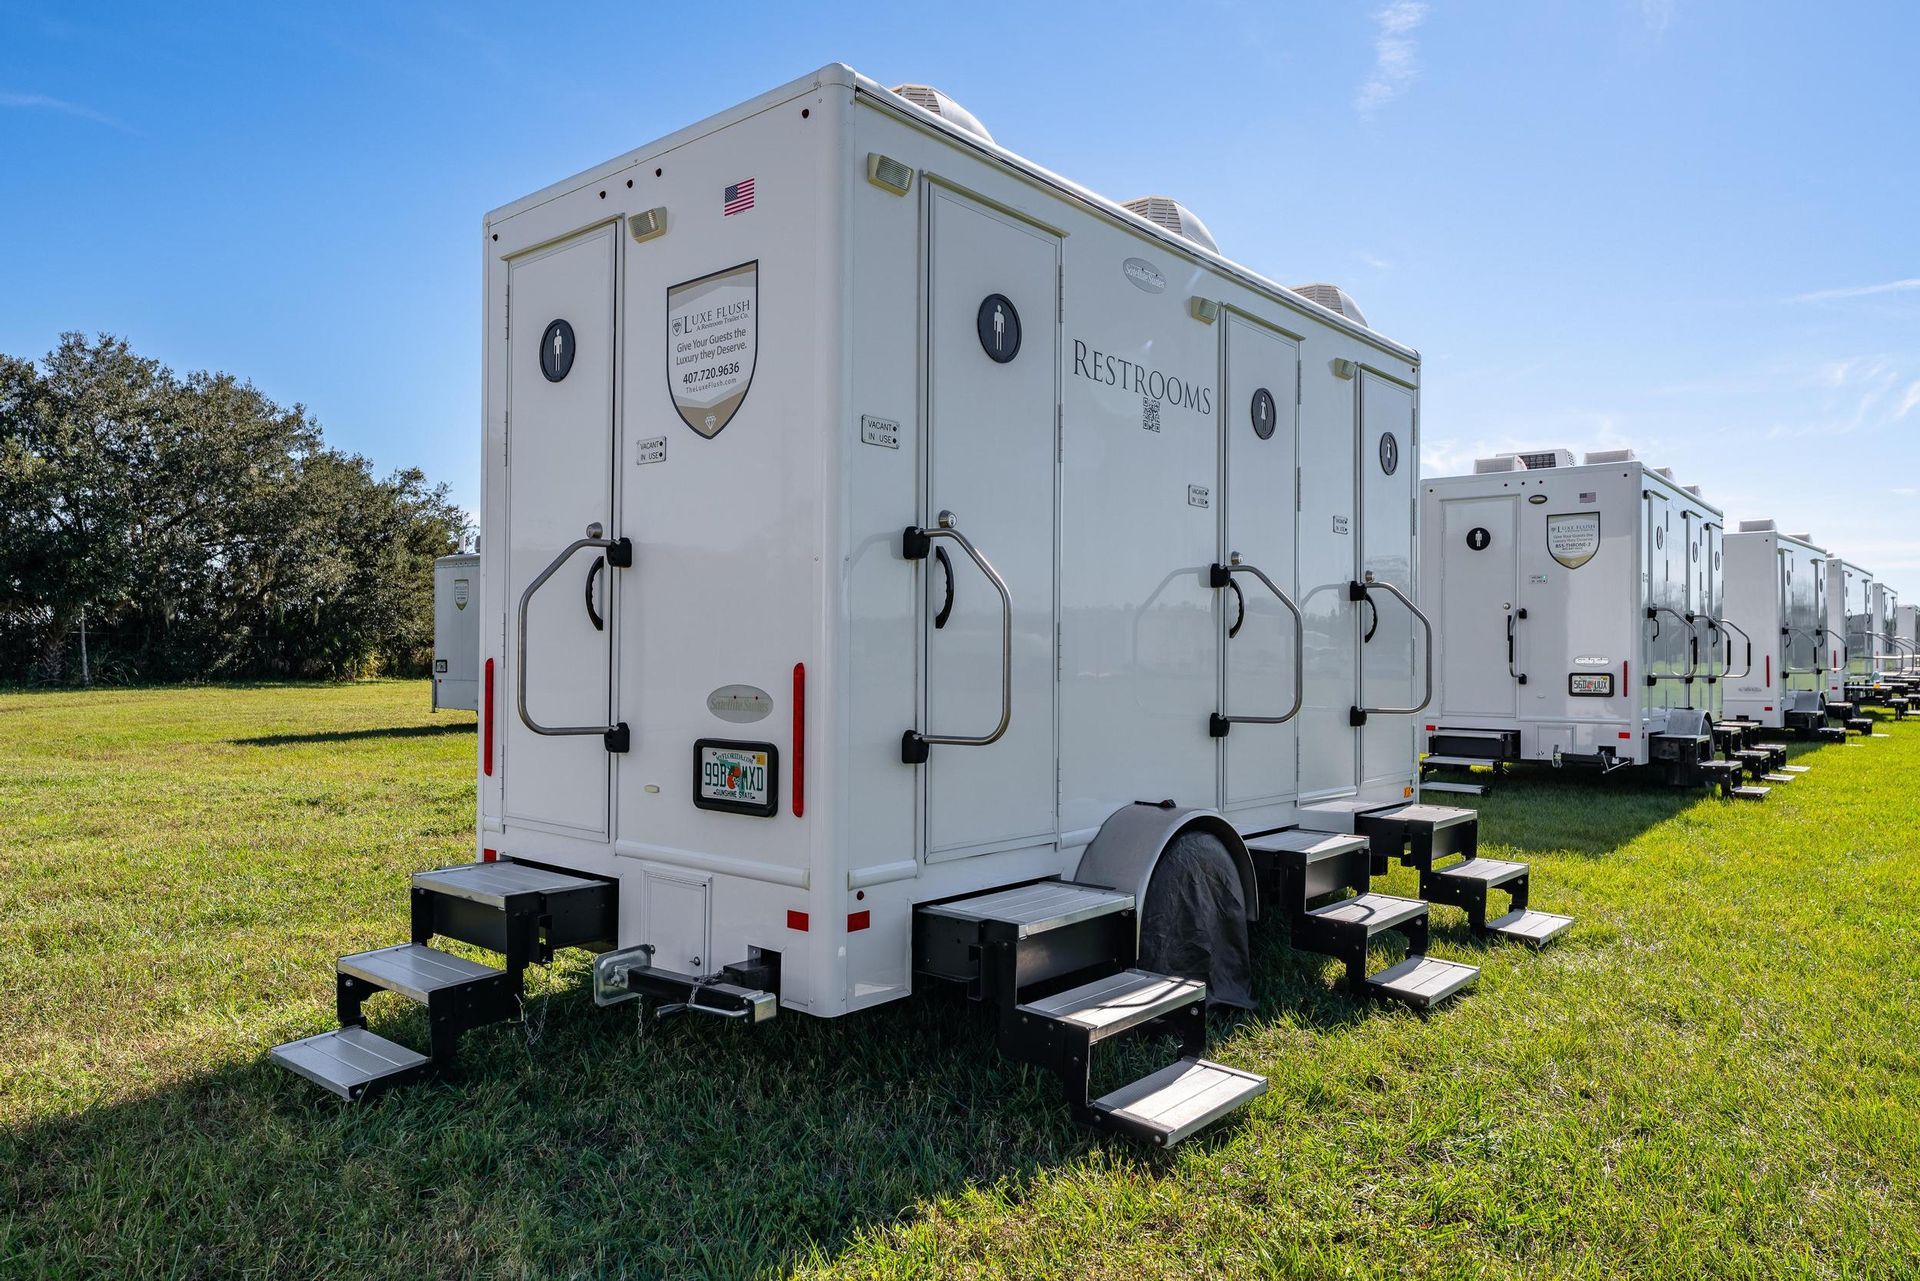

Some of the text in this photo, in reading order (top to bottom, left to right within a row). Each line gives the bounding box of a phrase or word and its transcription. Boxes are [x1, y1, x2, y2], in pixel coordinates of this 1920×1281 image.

[684, 300, 750, 334] LUXE FLUSH
[701, 319, 723, 330] Restroom
[724, 315, 739, 324] Trailer
[677, 328, 747, 353] Give Your Guests the
[676, 341, 747, 366] Luxury they Deserve.
[682, 361, 740, 385] 407.720.9636
[1073, 338, 1211, 415] RESTROOMS
[686, 377, 737, 394] TheLuxeFlush.com
[868, 420, 892, 431] VACANT
[640, 440, 659, 450] VACANT
[869, 432, 892, 444] IN USE
[649, 452, 659, 460] USE
[705, 762, 763, 792] 99B MXD
[715, 788, 754, 800] SUNSHINE STATE
